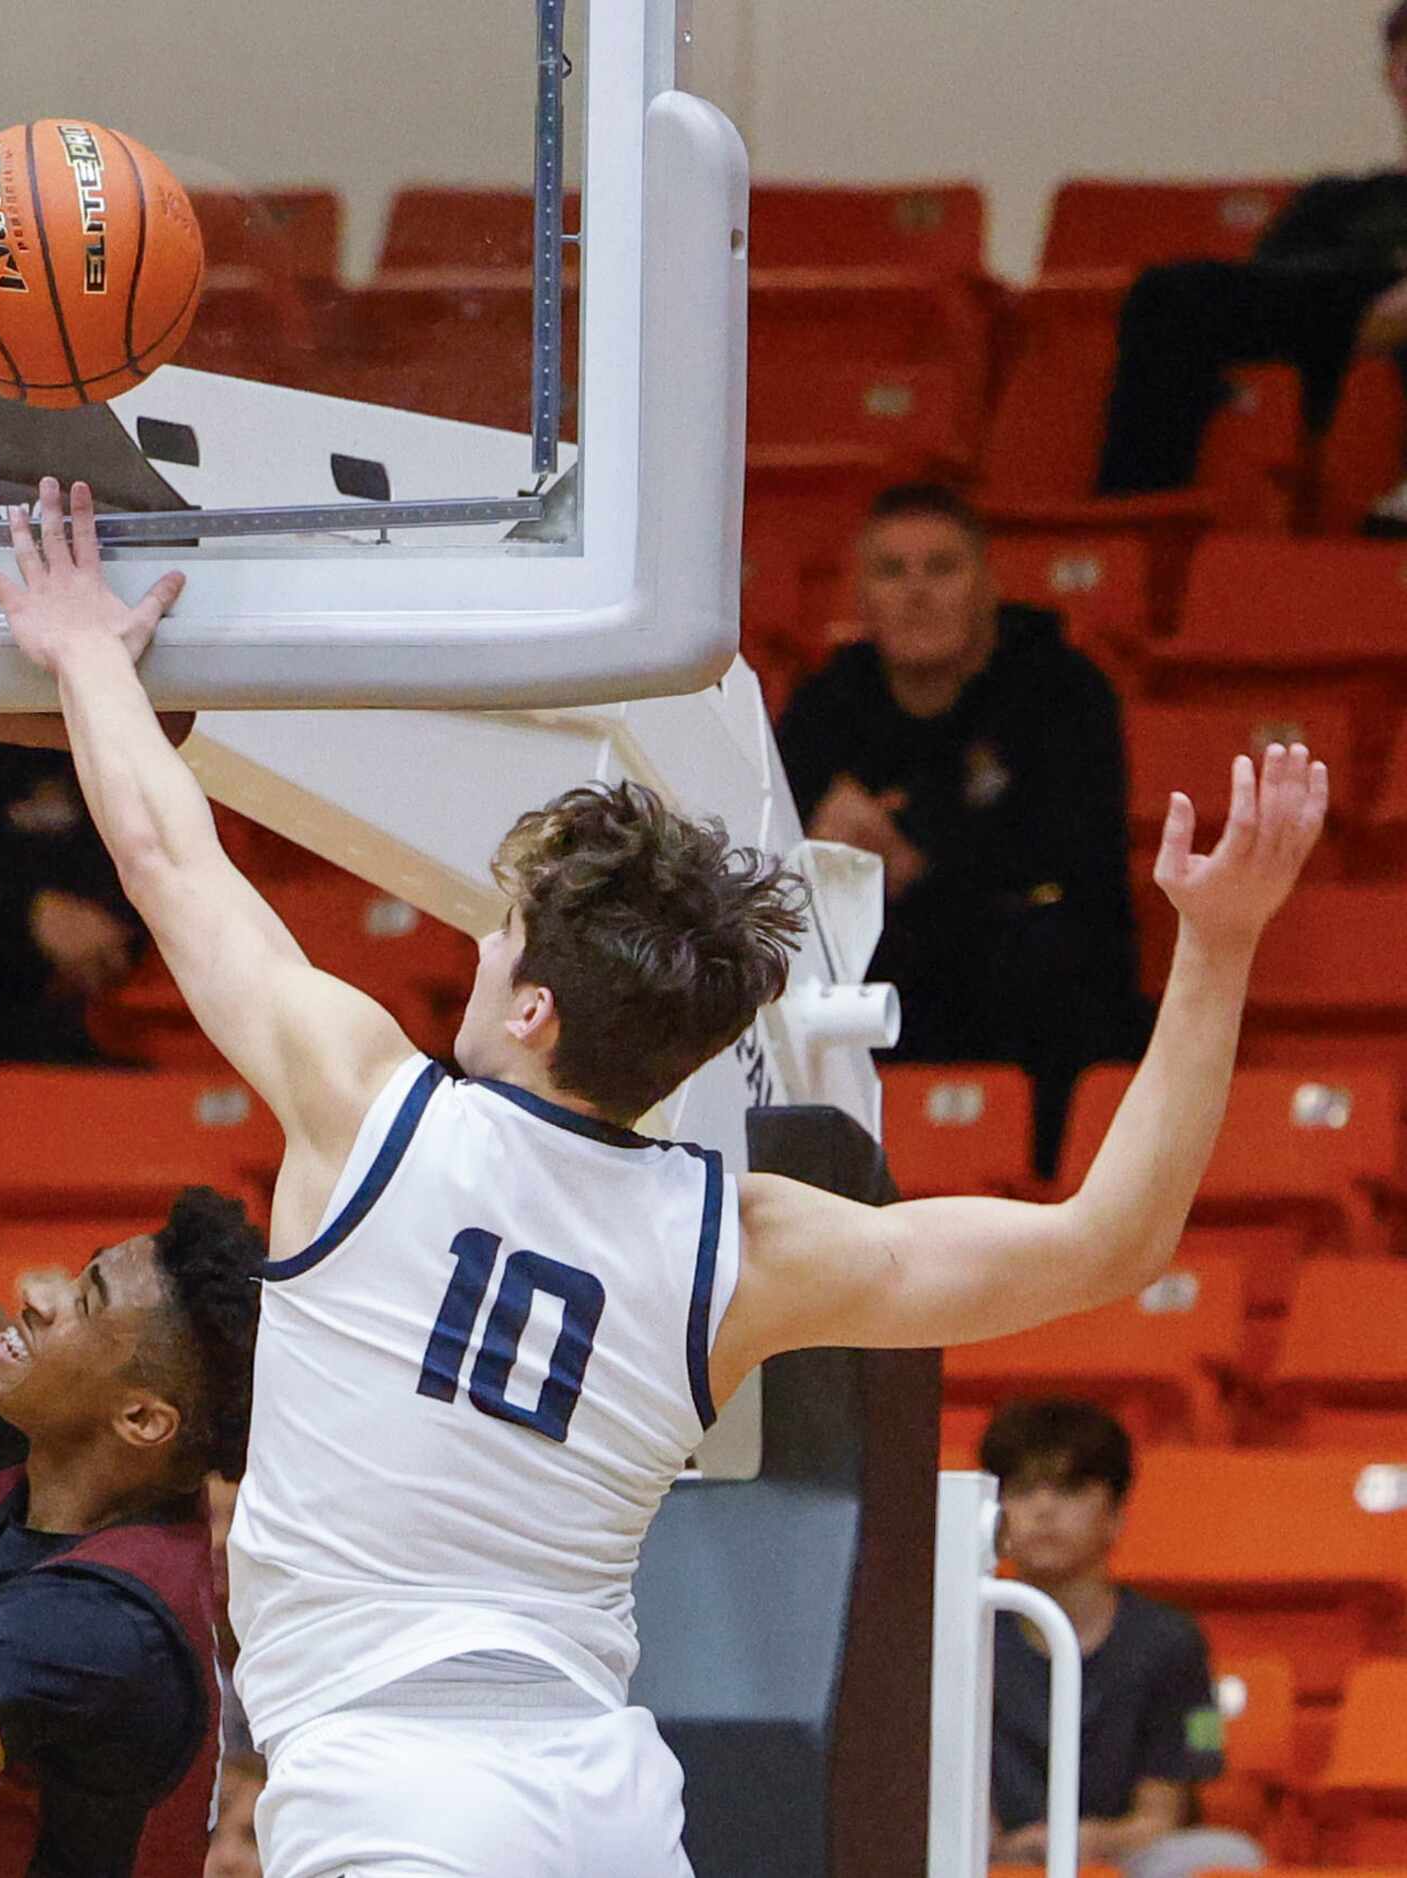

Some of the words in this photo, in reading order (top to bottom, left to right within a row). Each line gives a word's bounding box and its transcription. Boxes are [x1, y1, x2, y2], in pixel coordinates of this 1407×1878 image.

[58, 125, 104, 170] PRO
[74, 158, 107, 294] ELITE
[416, 1227, 606, 1443] 10
